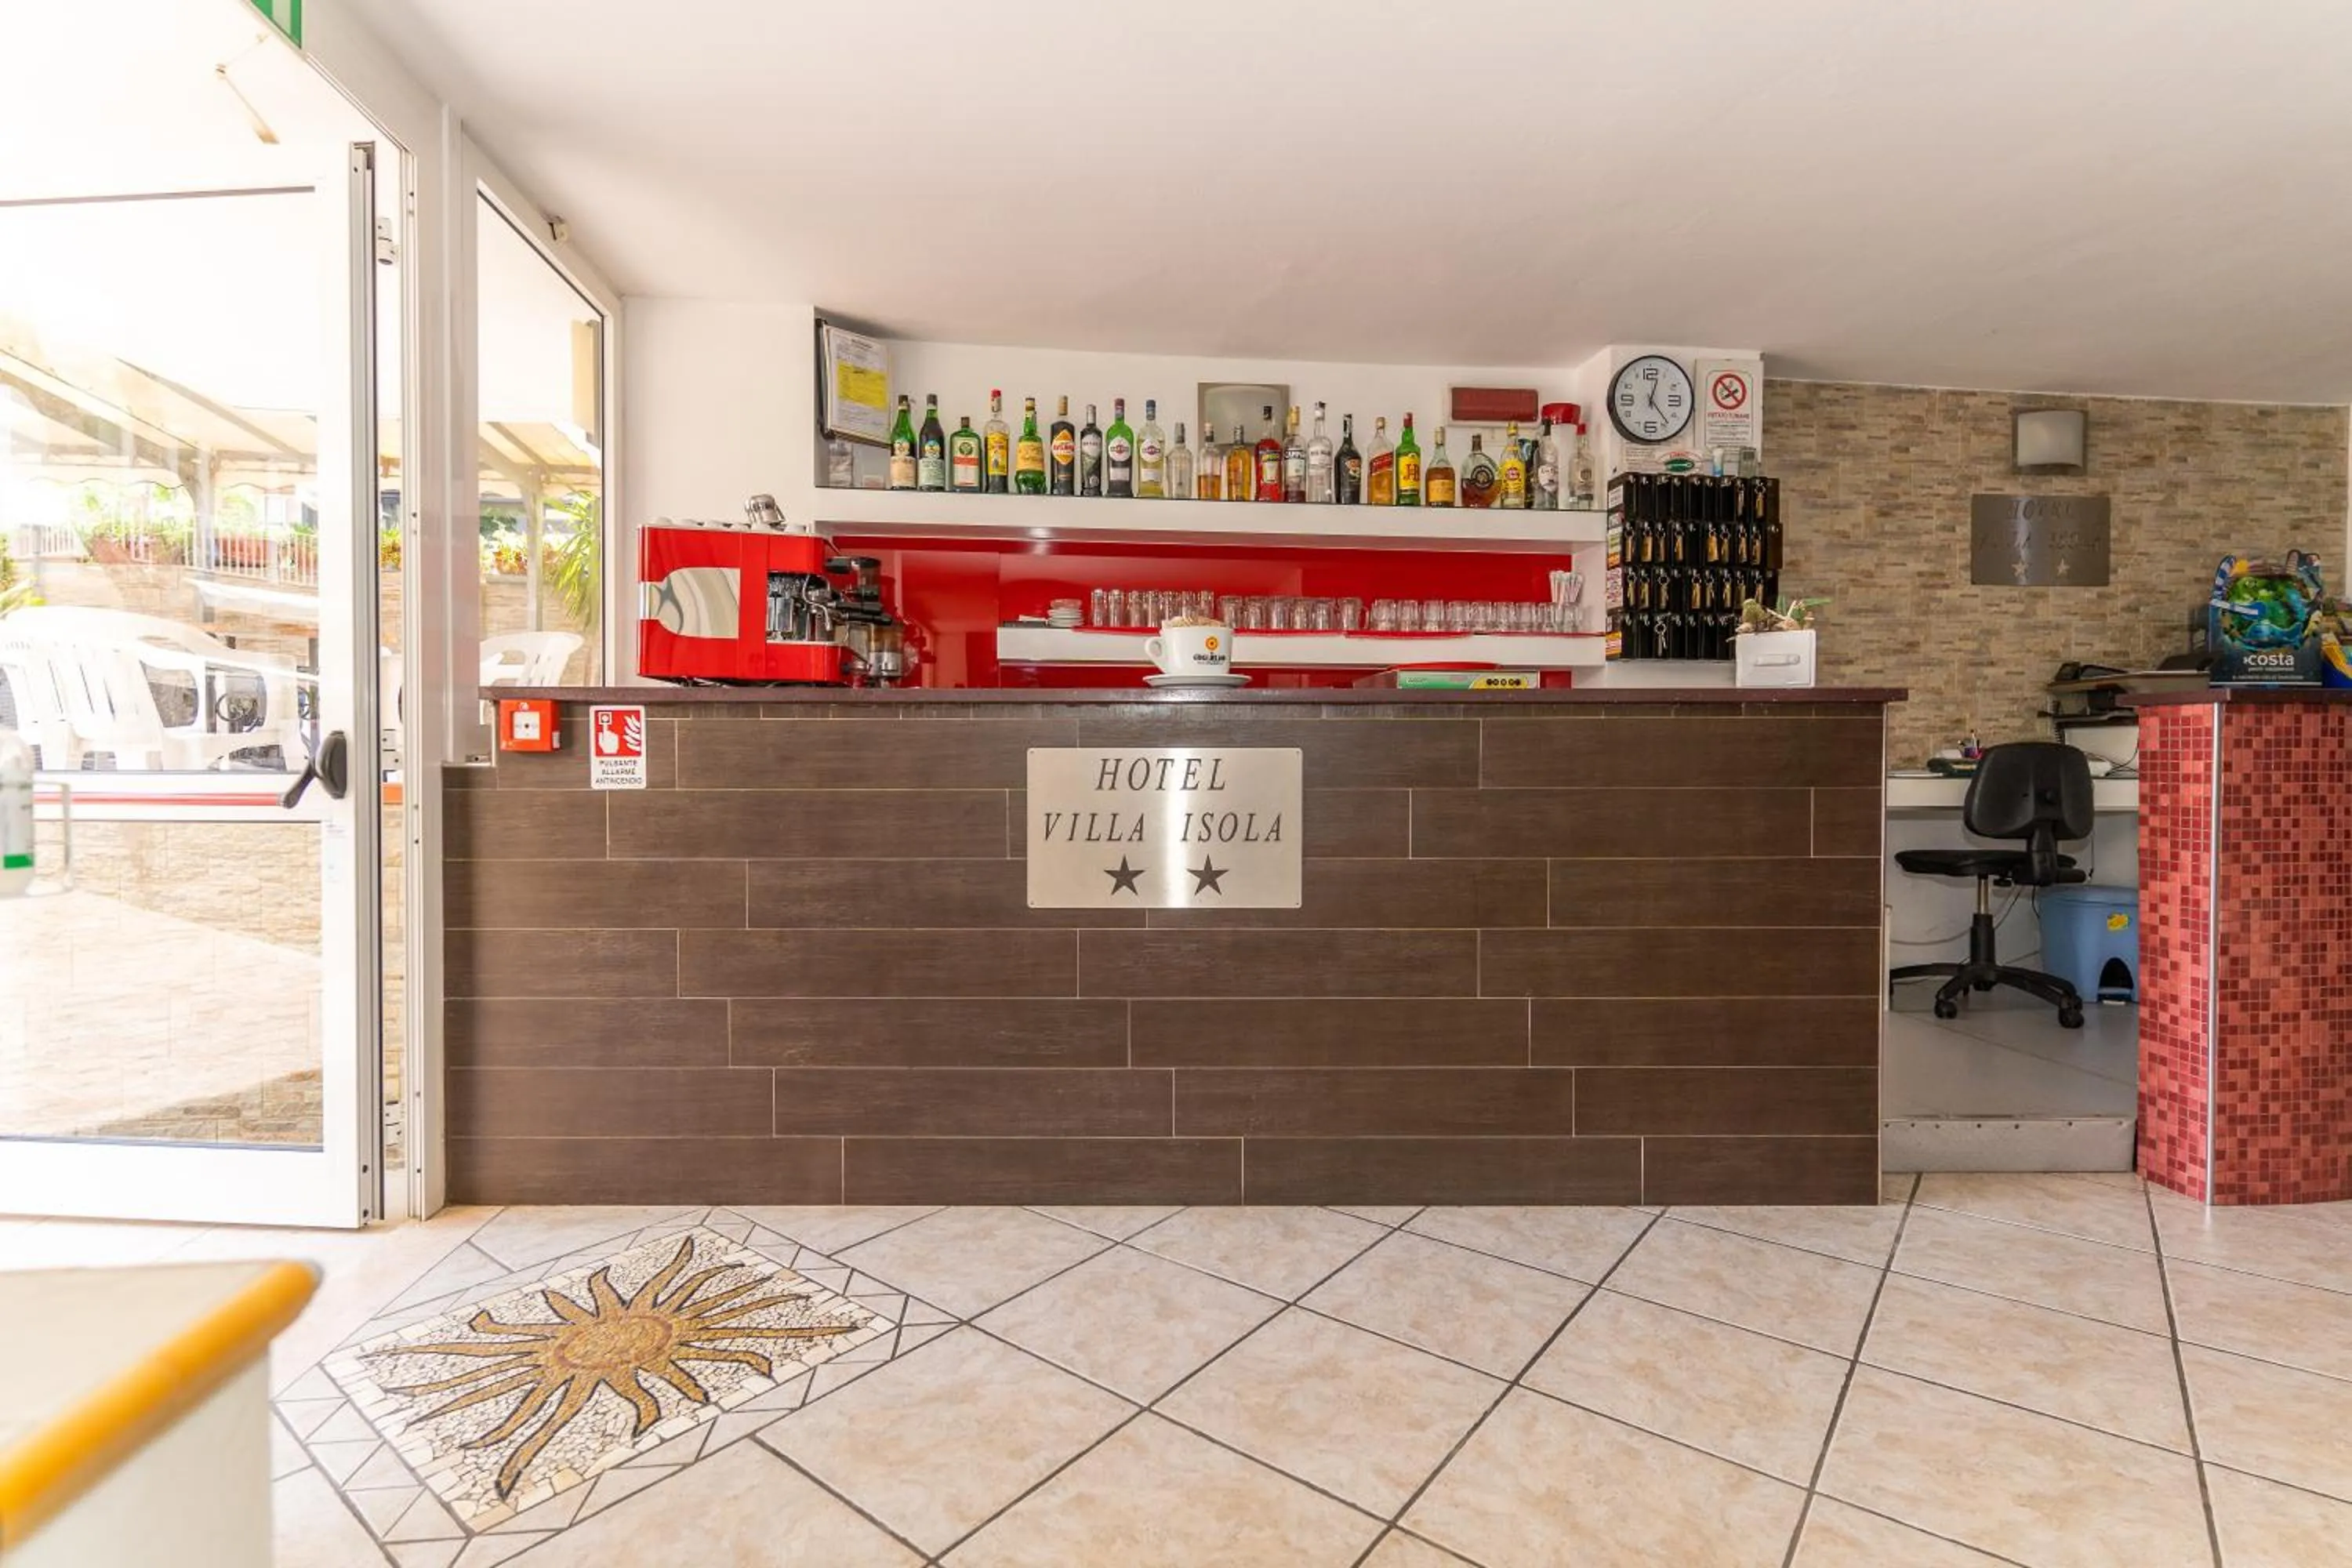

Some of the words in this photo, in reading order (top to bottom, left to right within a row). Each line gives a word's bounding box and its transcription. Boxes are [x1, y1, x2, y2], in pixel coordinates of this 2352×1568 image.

[1643, 368, 1658, 380] 12
[1621, 394, 1634, 406] 9
[1668, 394, 1682, 407] 3
[1644, 421, 1657, 433] 6
[2248, 653, 2295, 666] costa
[1094, 757, 1227, 791] HOTEL
[1044, 812, 1145, 842] VILLA
[1181, 811, 1282, 842] ISOLA
